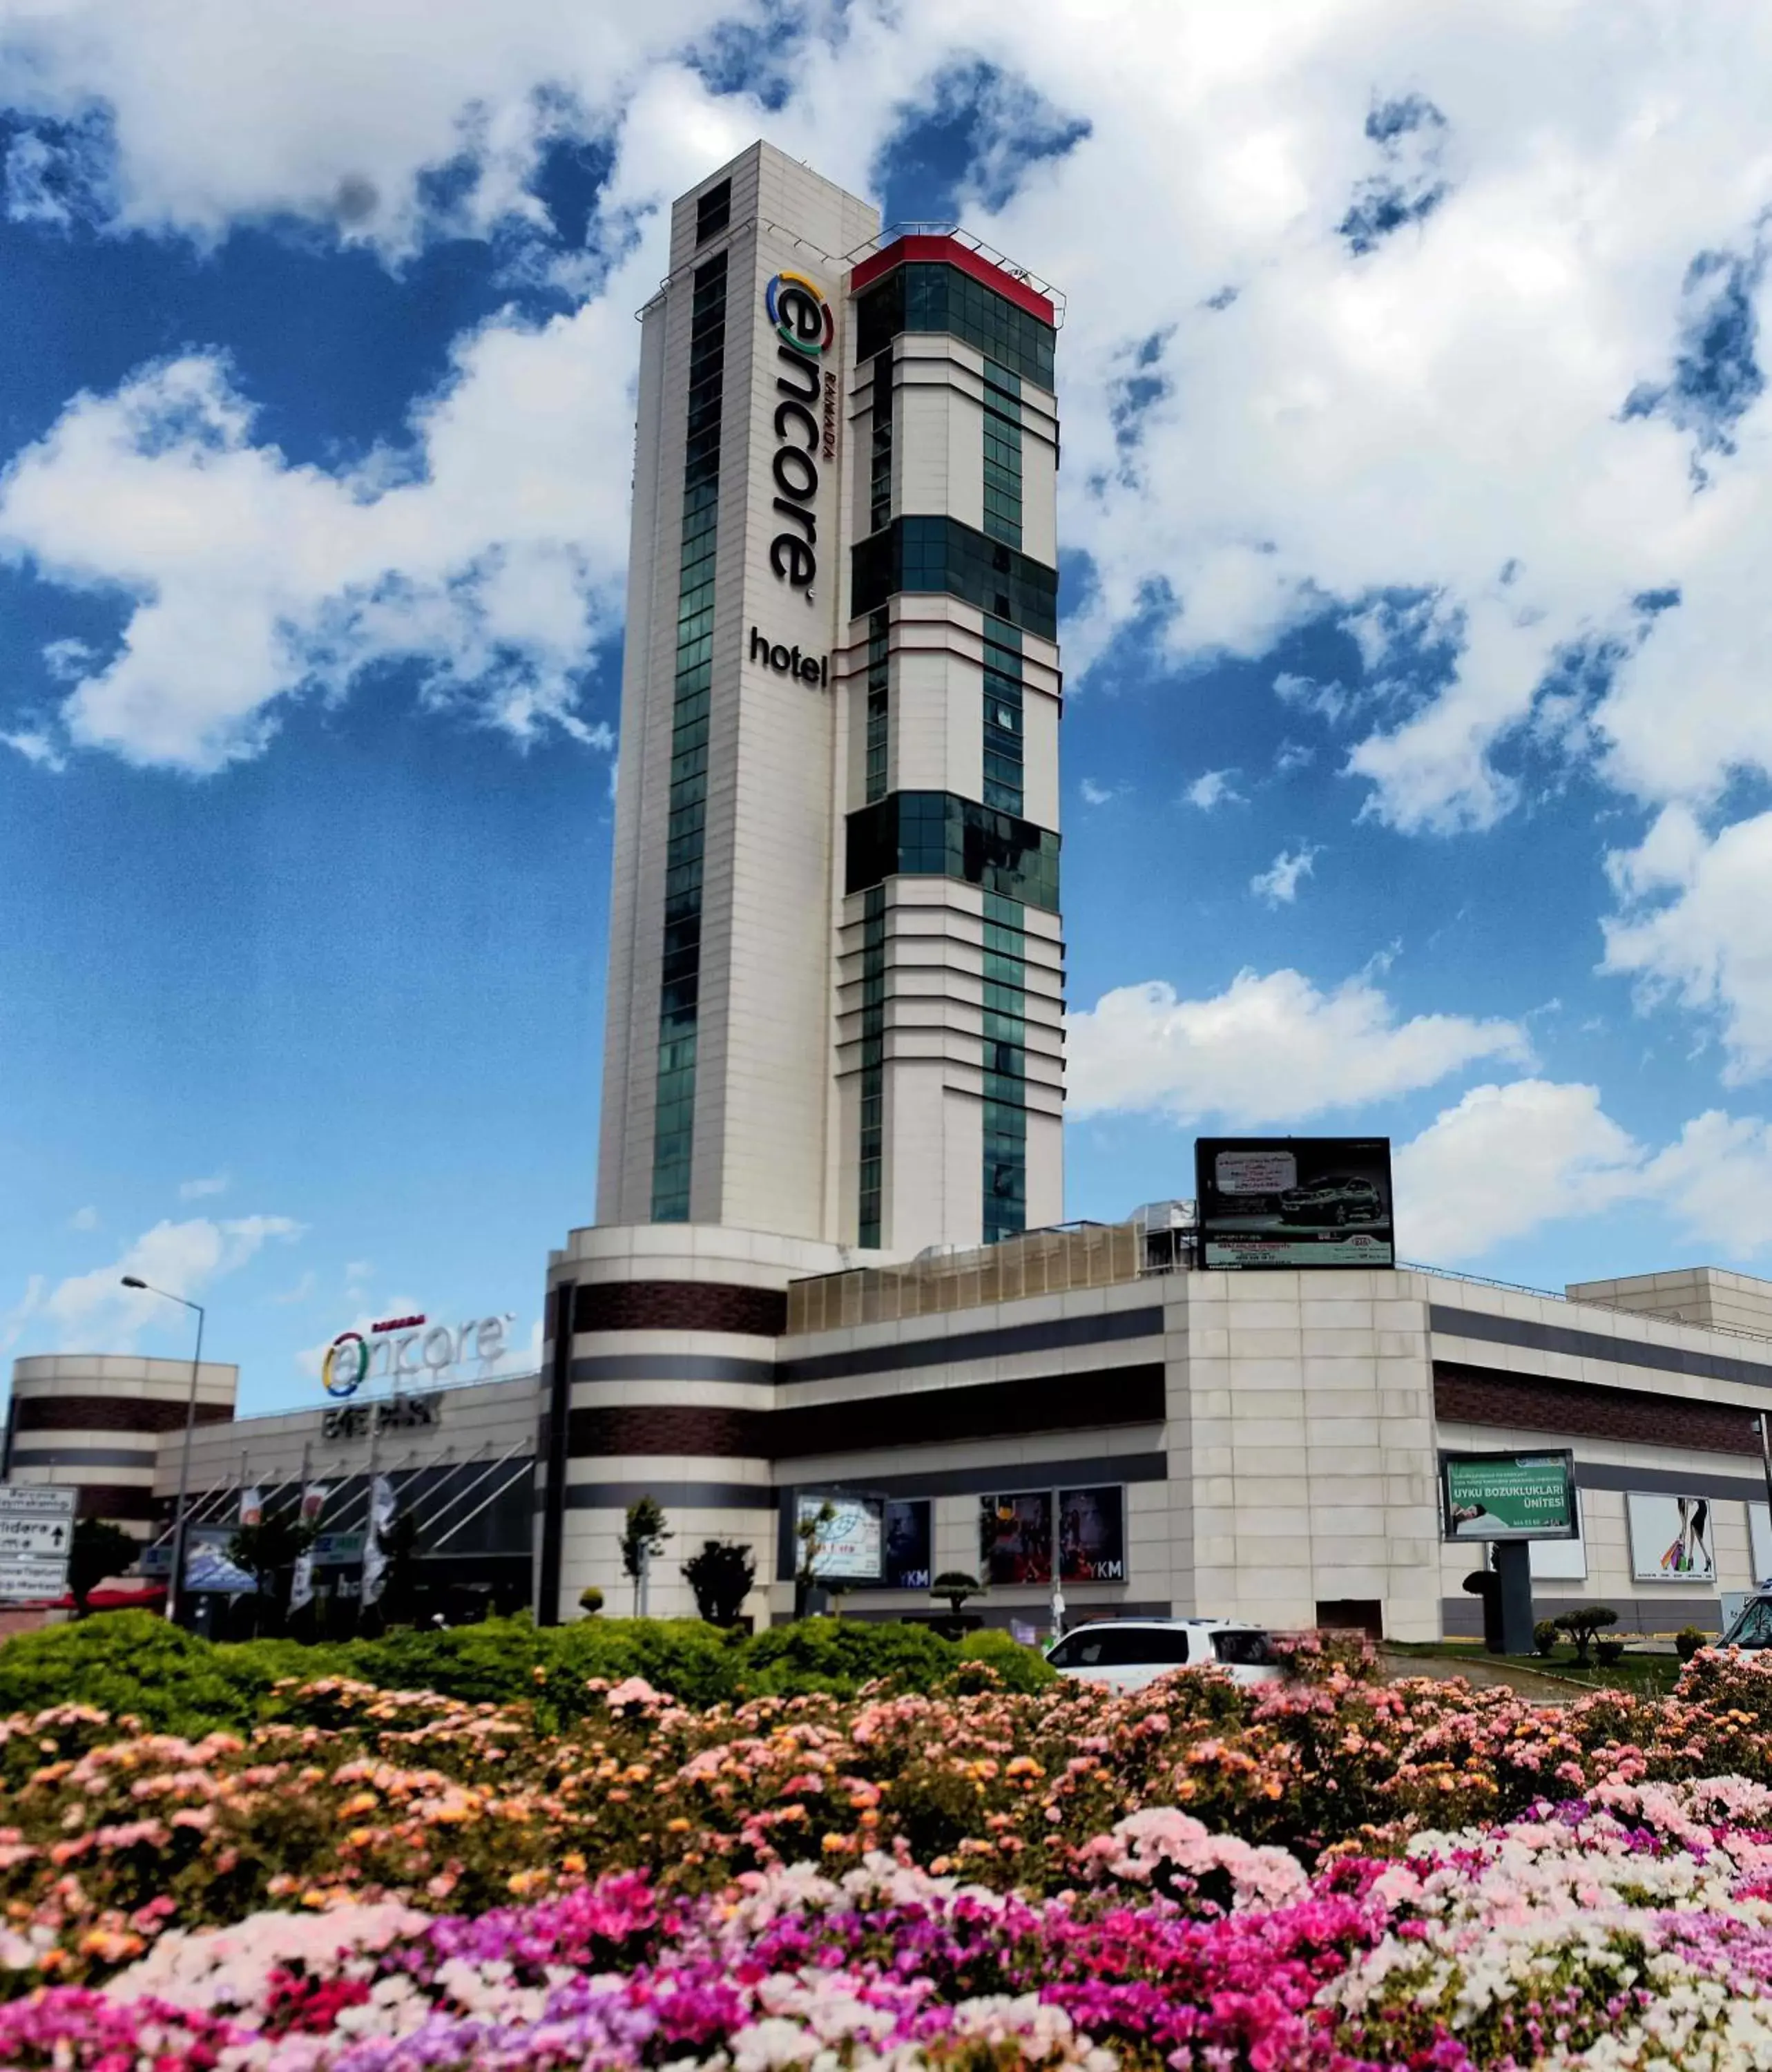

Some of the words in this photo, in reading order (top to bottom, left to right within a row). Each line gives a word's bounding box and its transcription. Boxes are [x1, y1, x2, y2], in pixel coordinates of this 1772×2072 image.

[824, 371, 837, 459] RAMADA
[769, 287, 823, 587] encore
[750, 626, 828, 688] hotel
[1454, 1488, 1483, 1498] UYKU
[1524, 1496, 1565, 1508] ÜNİTESİ
[898, 1569, 930, 1587] YKM
[1086, 1560, 1122, 1578] YKM
